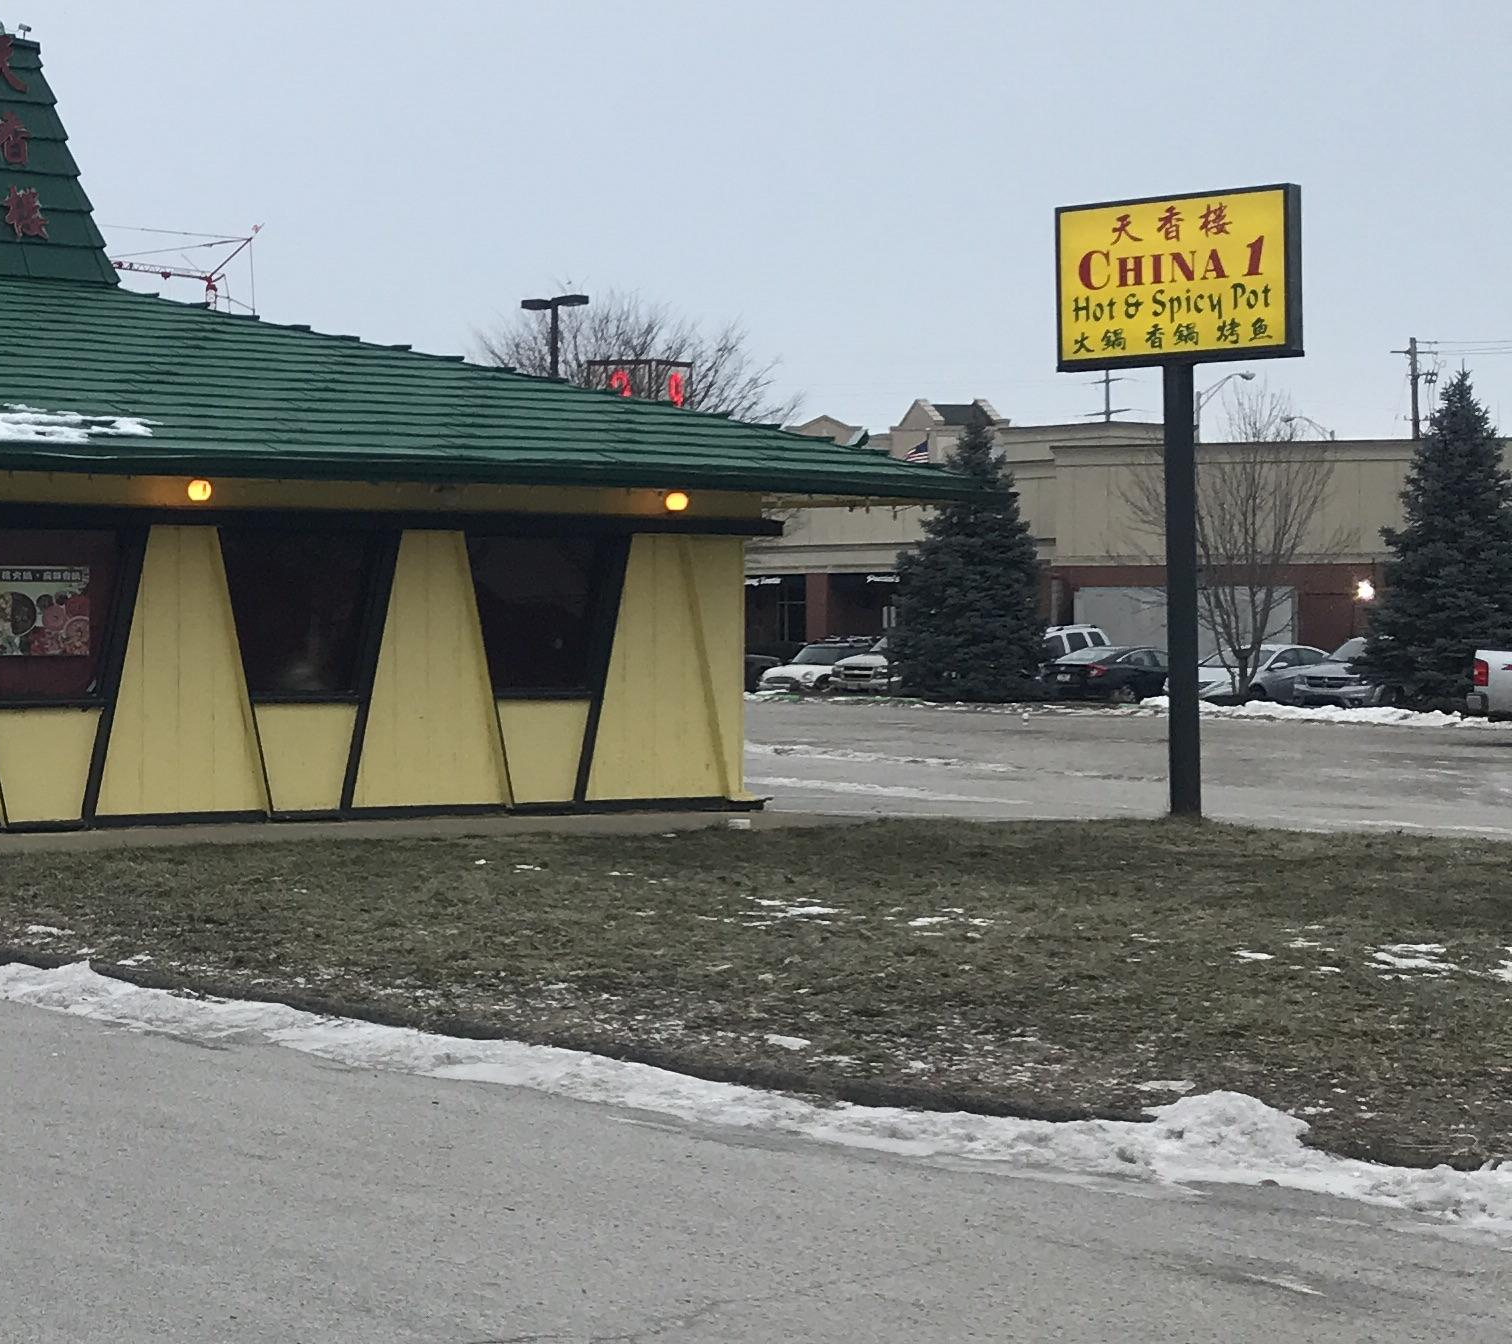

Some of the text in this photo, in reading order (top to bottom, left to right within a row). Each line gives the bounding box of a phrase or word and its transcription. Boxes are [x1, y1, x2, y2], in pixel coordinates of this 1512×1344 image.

[1078, 235, 1265, 291] CHINA 1
[1072, 282, 1272, 323] Hot & Spicy Pot
